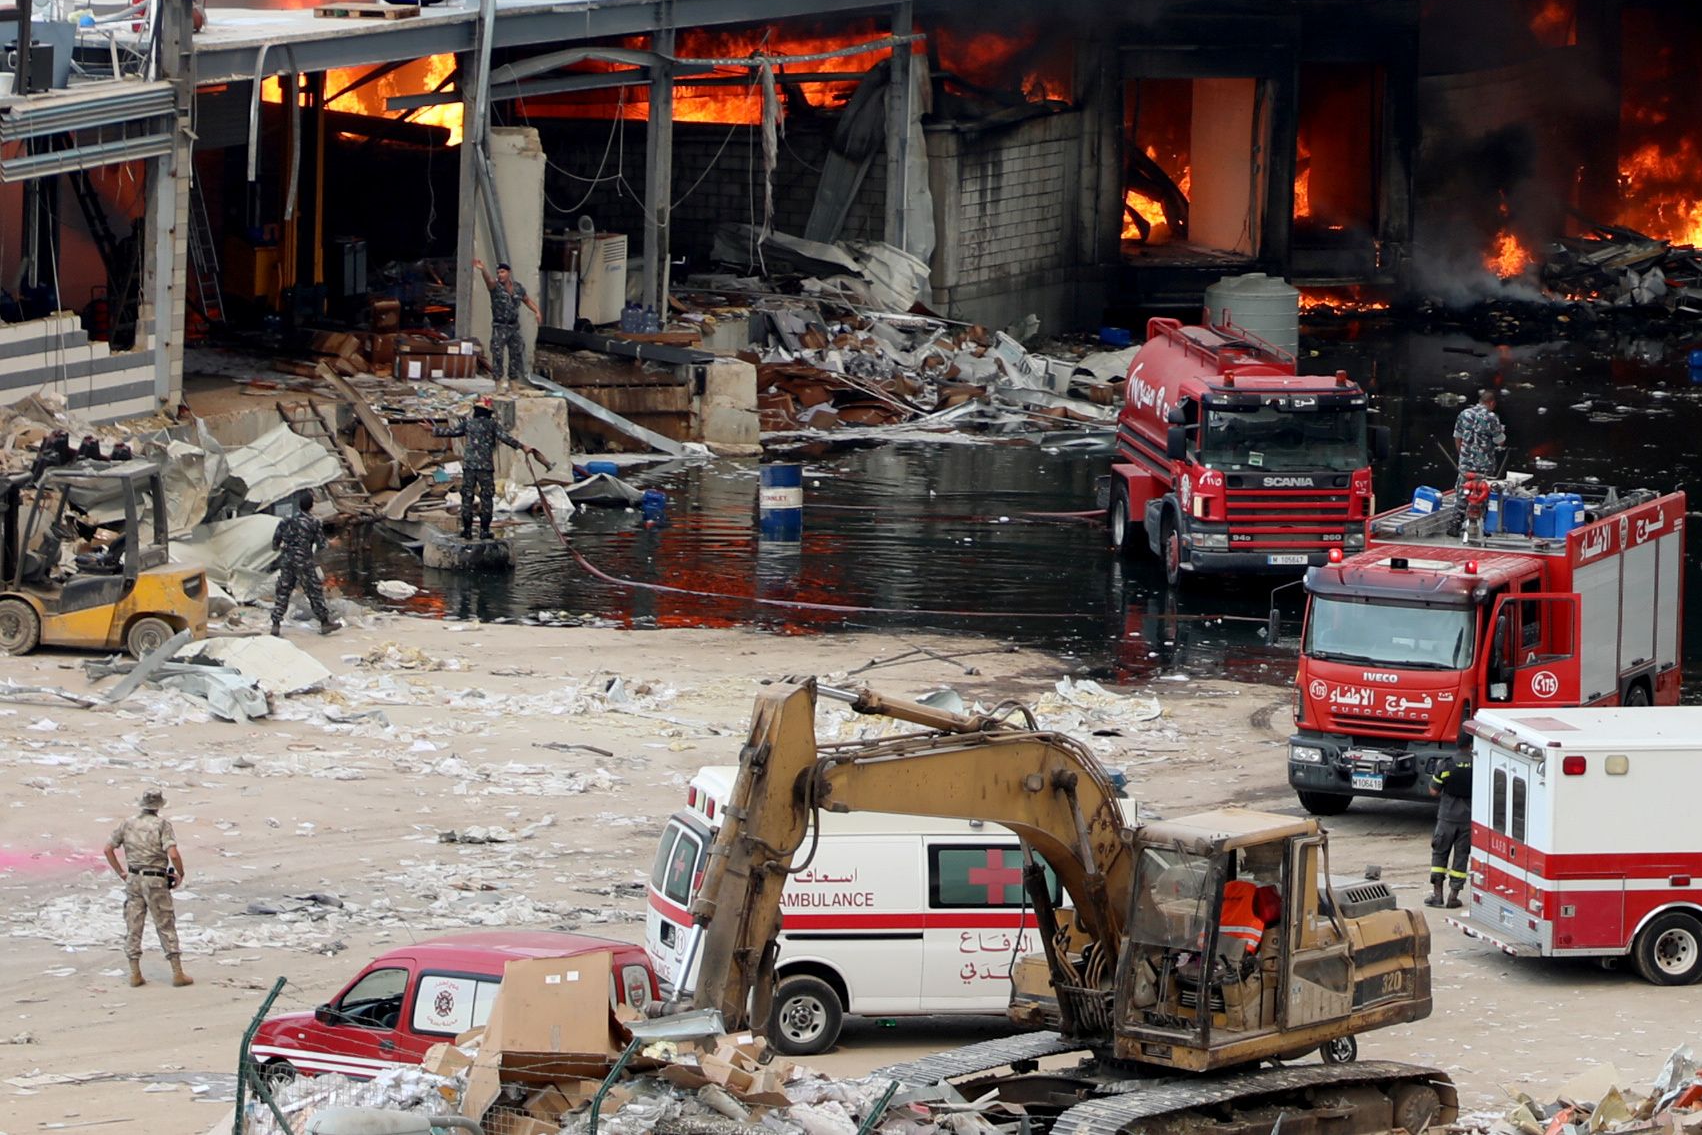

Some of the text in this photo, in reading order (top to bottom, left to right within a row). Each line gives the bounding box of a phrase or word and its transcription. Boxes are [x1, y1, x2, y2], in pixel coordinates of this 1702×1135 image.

[1263, 476, 1314, 487] SCANIA
[1363, 672, 1398, 683] IVECO
[1328, 686, 1433, 712] فوج الاطفاء
[1330, 705, 1430, 720] EUROCARGO
[793, 867, 858, 884] اسعاف
[779, 892, 874, 908] AMBULANCE
[1382, 970, 1403, 994] 320
